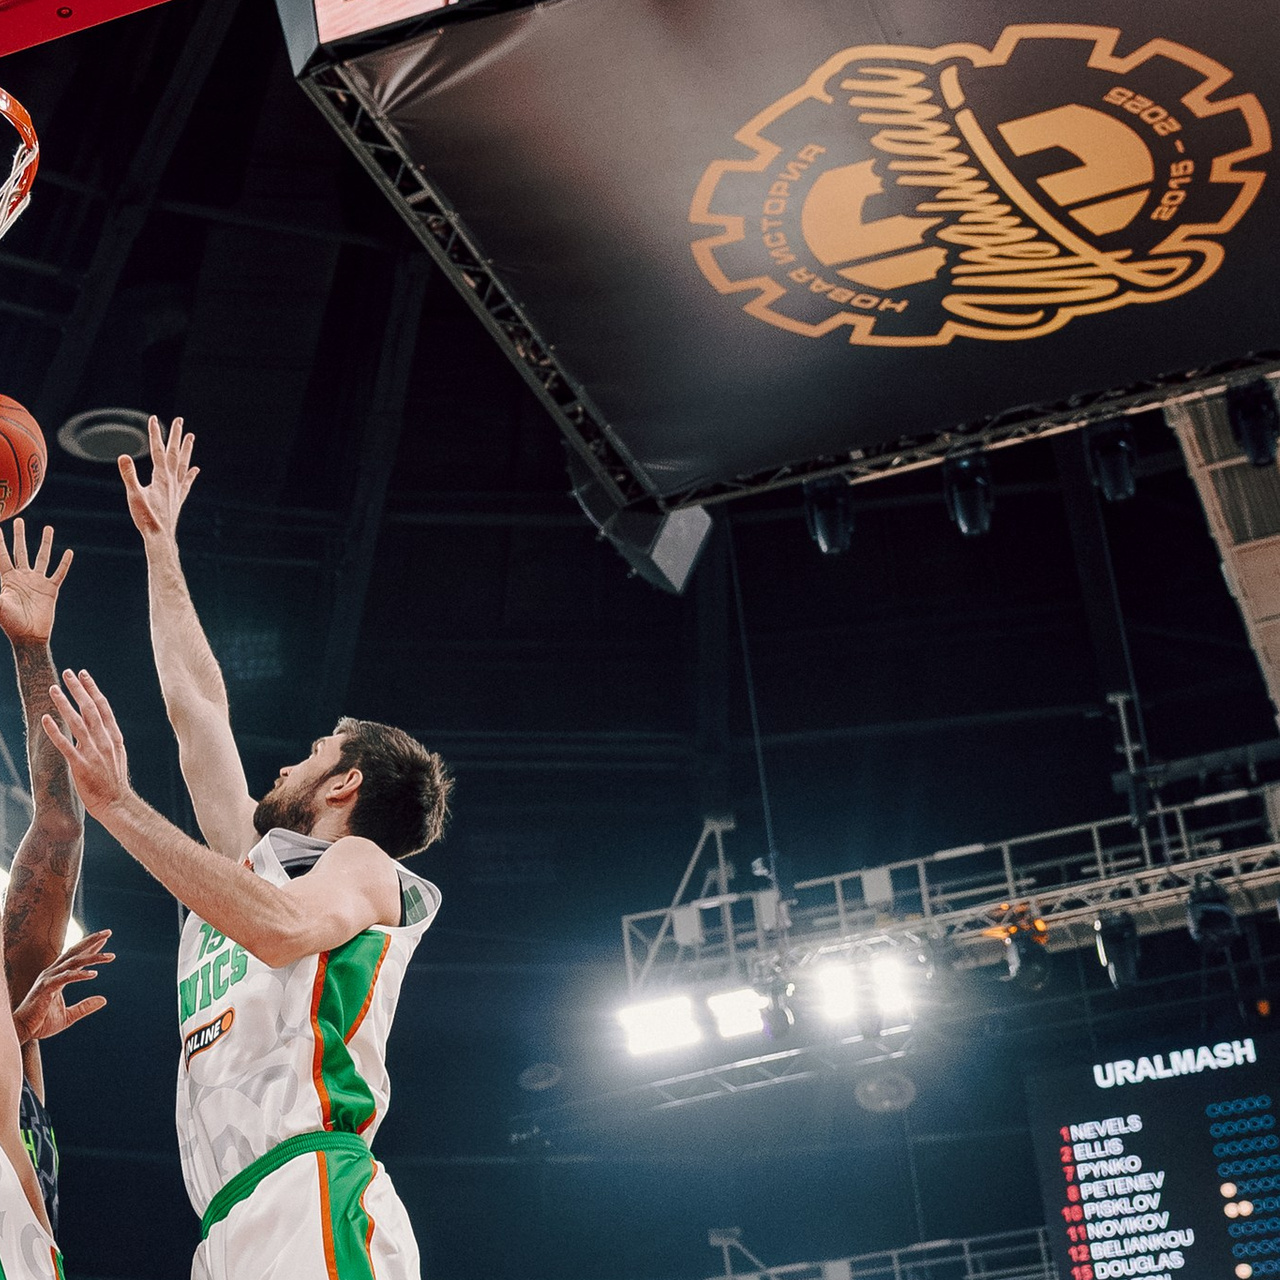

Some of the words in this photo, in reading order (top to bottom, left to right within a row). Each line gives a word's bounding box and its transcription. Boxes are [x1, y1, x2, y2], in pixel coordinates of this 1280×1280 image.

[760, 143, 827, 264] ИСТОРИЯ
[790, 269, 910, 315] НОВАЯ
[179, 943, 249, 1026] NICS
[186, 1019, 222, 1058] NLINE
[1093, 1038, 1257, 1089] URALMASH
[1060, 1126, 1070, 1142] 1
[1070, 1114, 1143, 1142] NEVELS
[1060, 1145, 1073, 1163] 2
[1073, 1137, 1124, 1161] ELLIS
[1063, 1165, 1075, 1182] 7
[1076, 1155, 1142, 1180] PYNKO
[1080, 1170, 1165, 1200] PETENEV
[1083, 1192, 1161, 1220] PISKLOV
[1066, 1224, 1087, 1242] 11
[1086, 1211, 1169, 1240] NOVIKOV
[1068, 1244, 1090, 1263] 12
[1090, 1228, 1195, 1260] BELIANKOU
[1094, 1250, 1185, 1280] DOUGLAS
